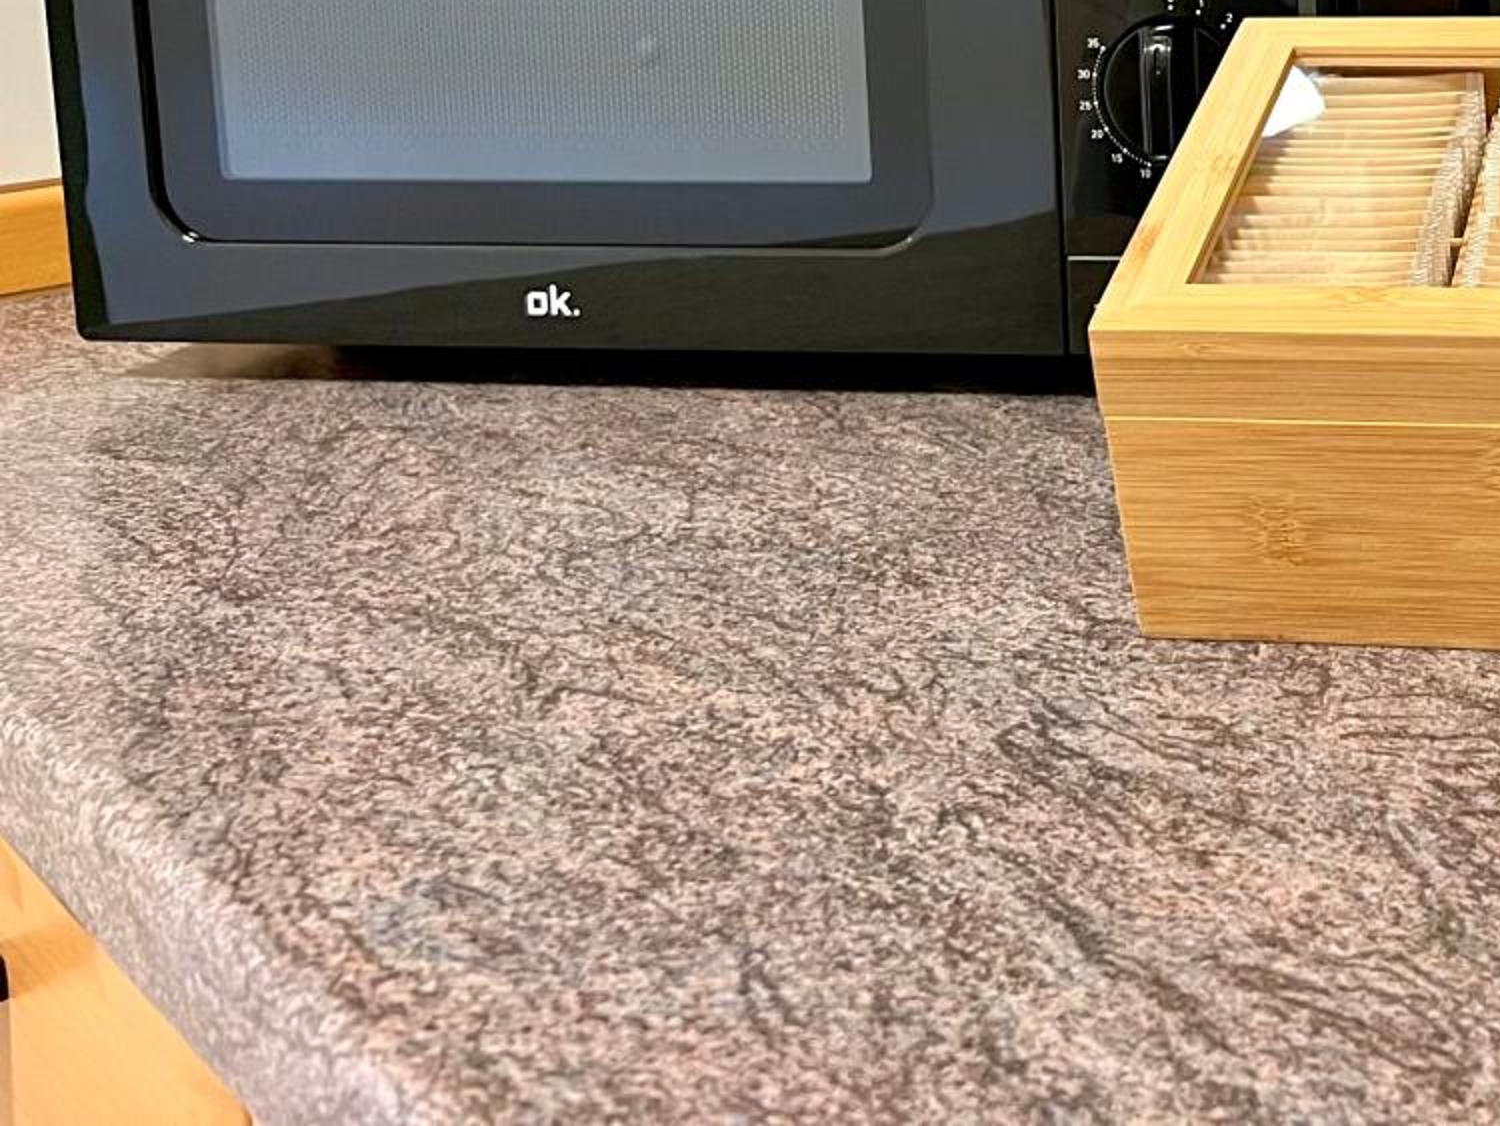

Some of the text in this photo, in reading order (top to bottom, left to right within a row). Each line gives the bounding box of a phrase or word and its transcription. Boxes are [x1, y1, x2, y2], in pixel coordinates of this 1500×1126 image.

[1225, 12, 1233, 24] 2
[1087, 37, 1100, 49] 35
[1077, 69, 1091, 80] 30
[1079, 100, 1092, 111] 25
[1090, 129, 1104, 140] 20
[1111, 152, 1123, 164] 15
[526, 283, 581, 316] ok.
